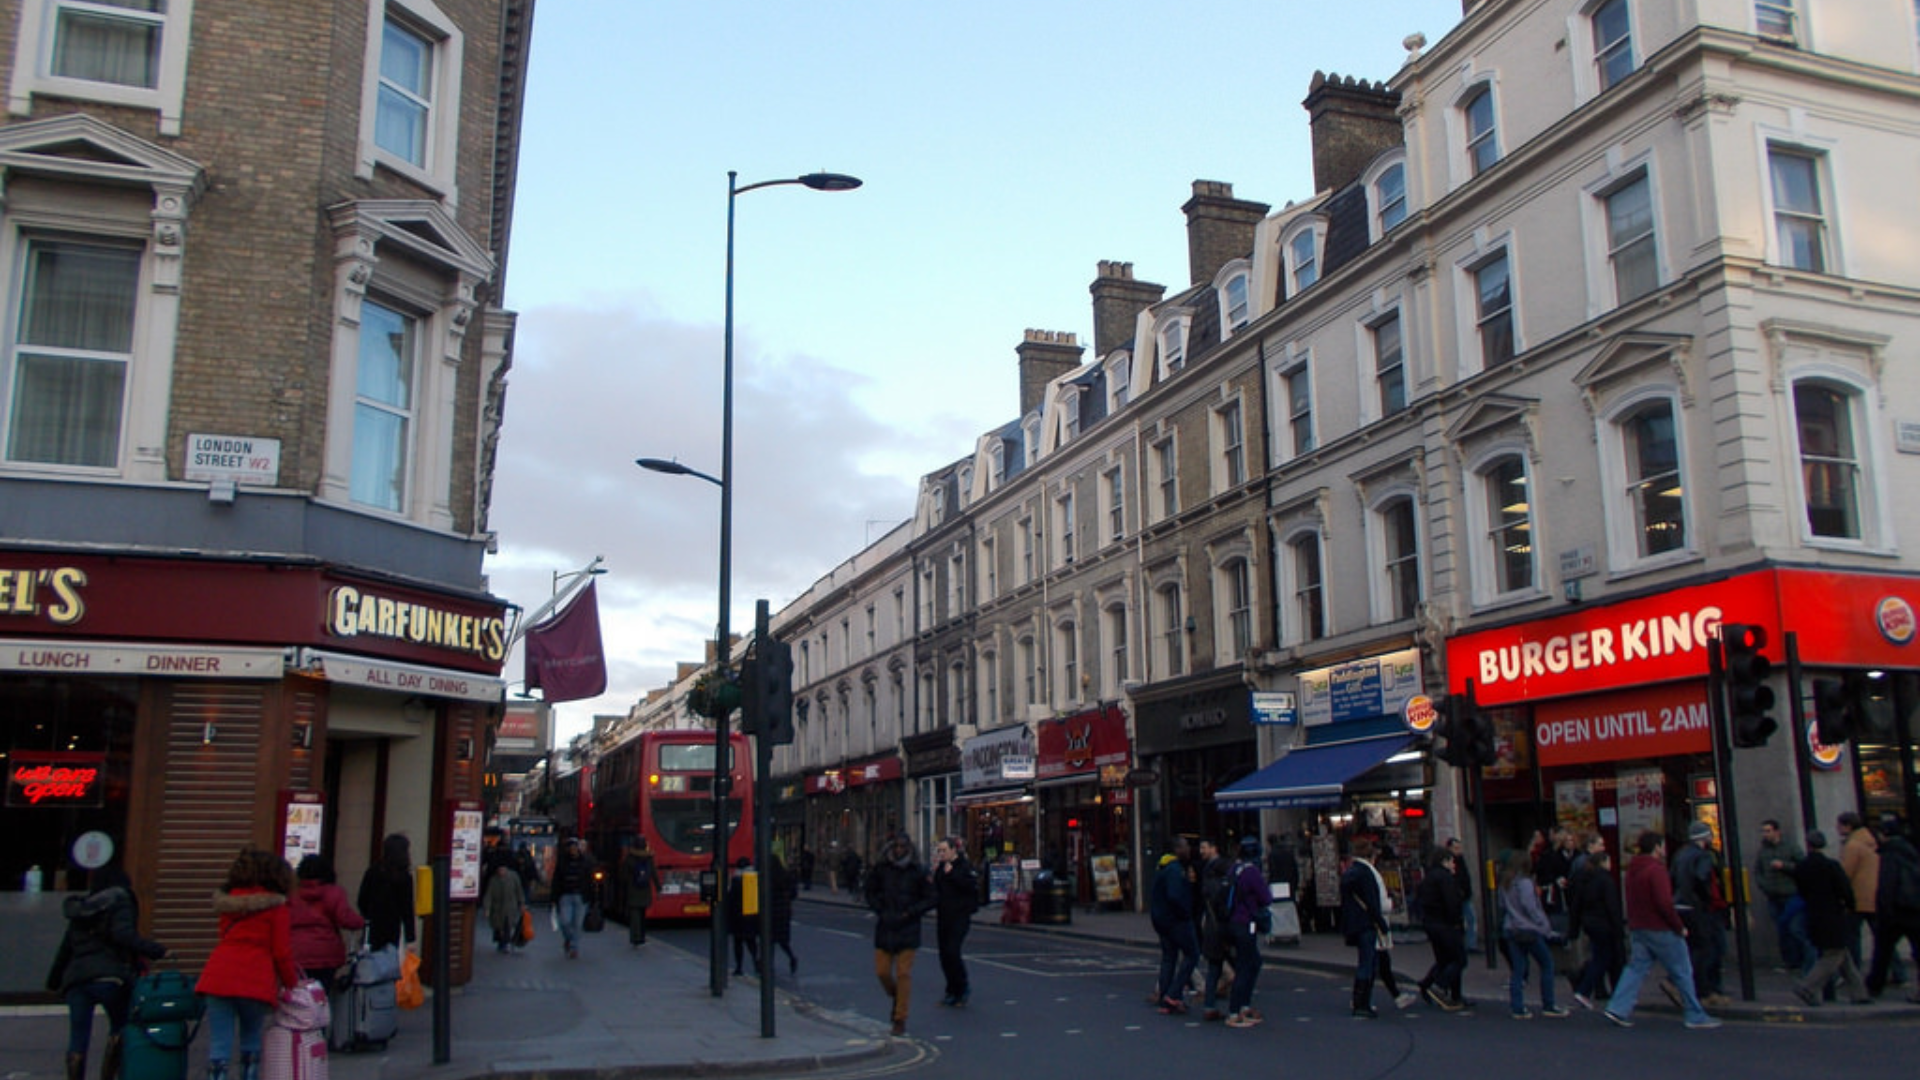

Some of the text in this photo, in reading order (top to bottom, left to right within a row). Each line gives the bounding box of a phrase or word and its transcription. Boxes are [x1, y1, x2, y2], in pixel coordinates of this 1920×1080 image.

[195, 438, 253, 454] LONDON
[194, 452, 271, 470] STREET W2
[328, 585, 504, 661] GARFUNKEL'S
[1478, 606, 1723, 685] BURGER KING
[18, 651, 220, 672] LUNCH DINNER
[366, 668, 468, 695] ALL DAY DINING
[1409, 709, 1435, 723] KING
[1536, 717, 1590, 746] OPEN
[1594, 711, 1655, 740] UNTIL
[1659, 702, 1709, 732] 2AM
[14, 764, 98, 783] we are
[22, 781, 86, 805] open
